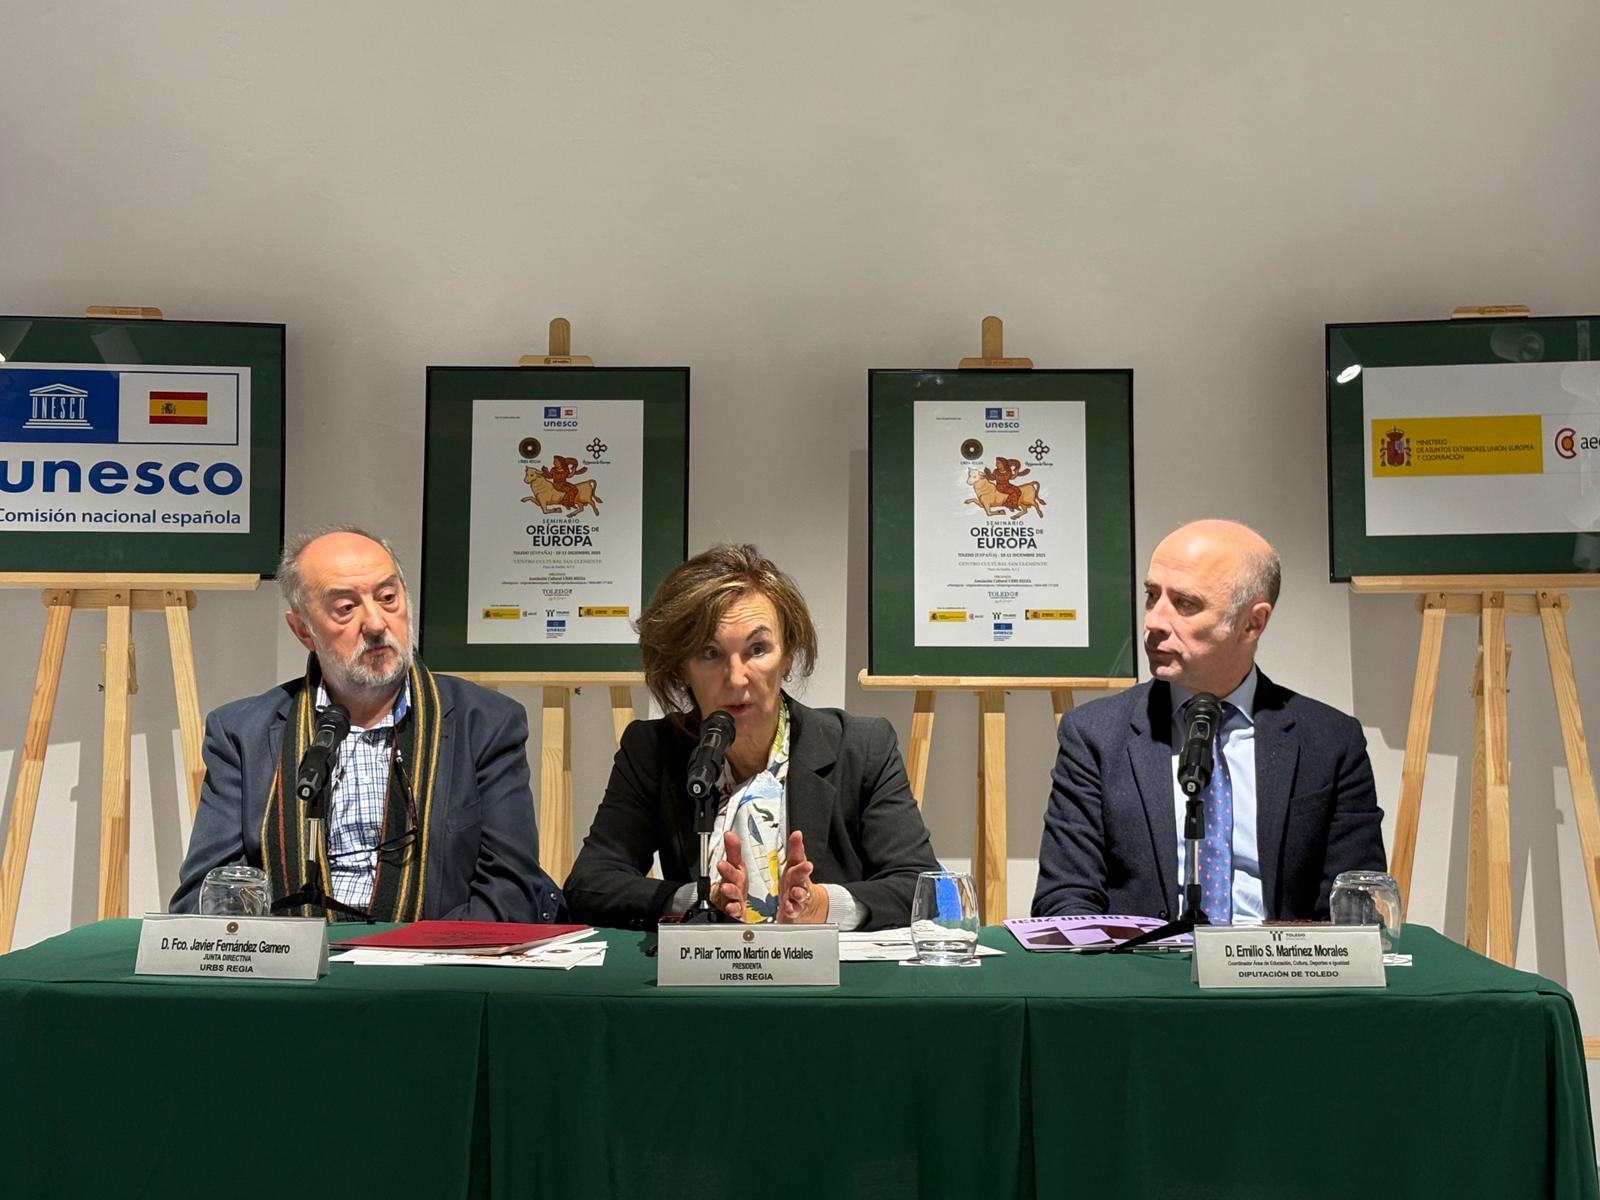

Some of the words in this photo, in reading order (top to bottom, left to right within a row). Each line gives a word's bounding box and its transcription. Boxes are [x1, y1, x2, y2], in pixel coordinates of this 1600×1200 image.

[32, 397, 85, 419] UNESCO
[543, 420, 578, 428] unesco
[985, 421, 1020, 429] unesco
[1423, 446, 1452, 454] ASUNTOS
[1487, 444, 1507, 452] UNIÓN
[1580, 436, 1600, 450] ae
[1422, 453, 1464, 461] COOPERACIÓN
[0, 459, 243, 496] unesco
[81, 508, 157, 524] nacional
[161, 510, 241, 527] española
[526, 523, 590, 535] ORÍGENES
[970, 525, 1035, 538] ORÍGENES
[532, 535, 593, 547] EUROPA
[977, 537, 1038, 549] EUROPA
[161, 937, 170, 950] D.
[171, 938, 188, 951] Fco.
[190, 938, 214, 951] Javier
[216, 938, 257, 953] Fernández
[259, 941, 290, 954] Gamero
[1225, 945, 1235, 957] D.
[1237, 945, 1264, 957] Emilio
[1265, 945, 1274, 957] S.
[1276, 944, 1313, 957] Martínez
[1314, 945, 1348, 957] Morales
[222, 954, 252, 962] DIRECTIVA
[694, 947, 713, 960] Pilar
[715, 947, 741, 960] Tormo
[743, 946, 769, 960] Martín
[771, 947, 781, 960] de
[783, 947, 813, 960] Vidales
[200, 963, 224, 972] URBS
[226, 964, 254, 973] REGIA
[732, 962, 762, 970] PRESIDENTA
[720, 973, 744, 981] URBS
[746, 973, 774, 981] REGIA
[1238, 970, 1289, 978] DIPUTACIÓN
